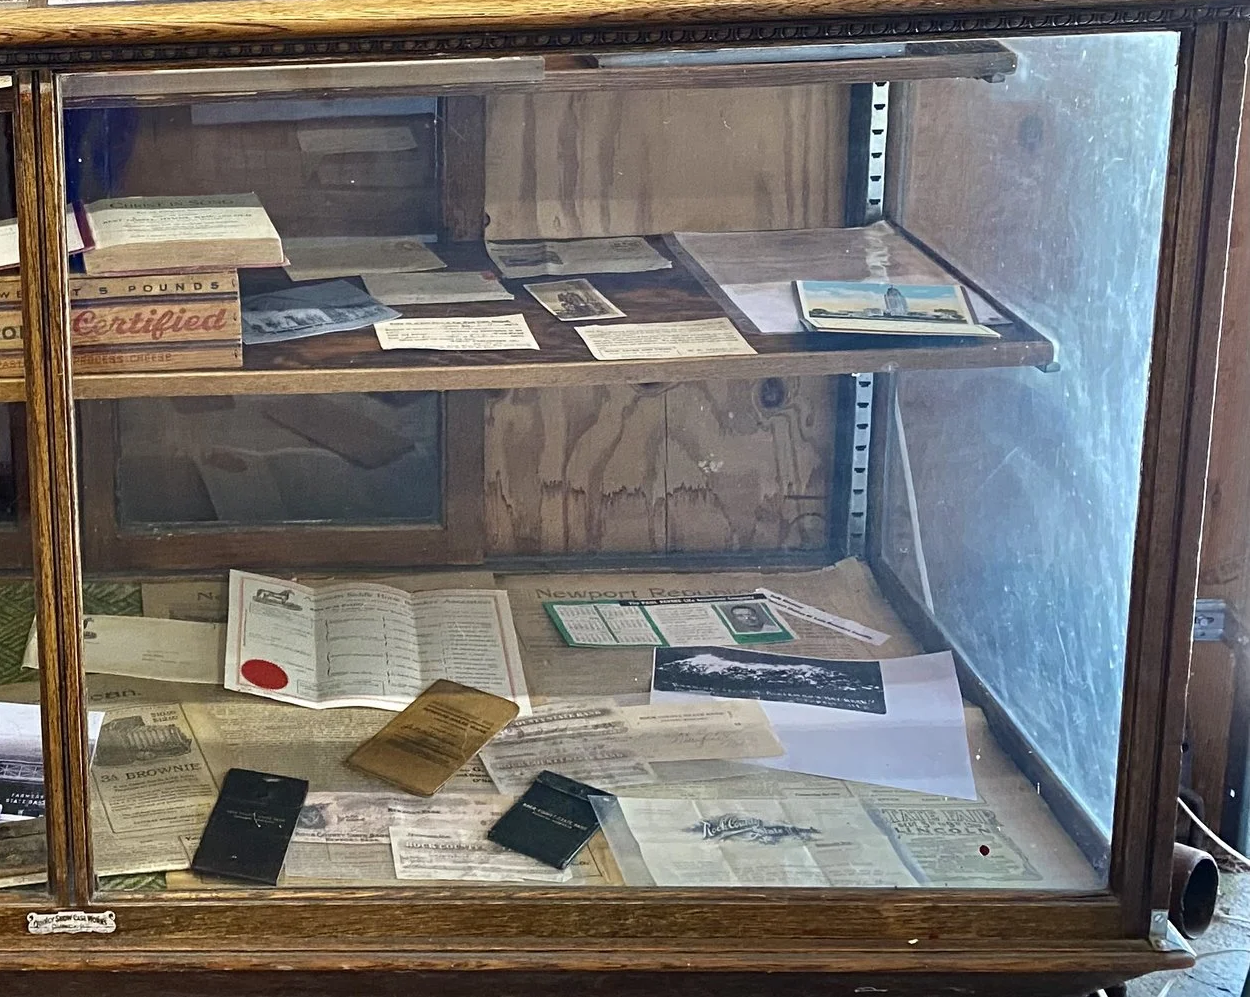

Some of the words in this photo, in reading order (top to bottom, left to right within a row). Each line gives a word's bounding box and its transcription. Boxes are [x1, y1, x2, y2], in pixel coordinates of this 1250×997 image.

[99, 287, 108, 295] 5
[128, 282, 219, 292] POUNDS
[73, 308, 227, 340] Certified
[535, 588, 638, 601] Newport
[126, 763, 202, 783] BROWNIE
